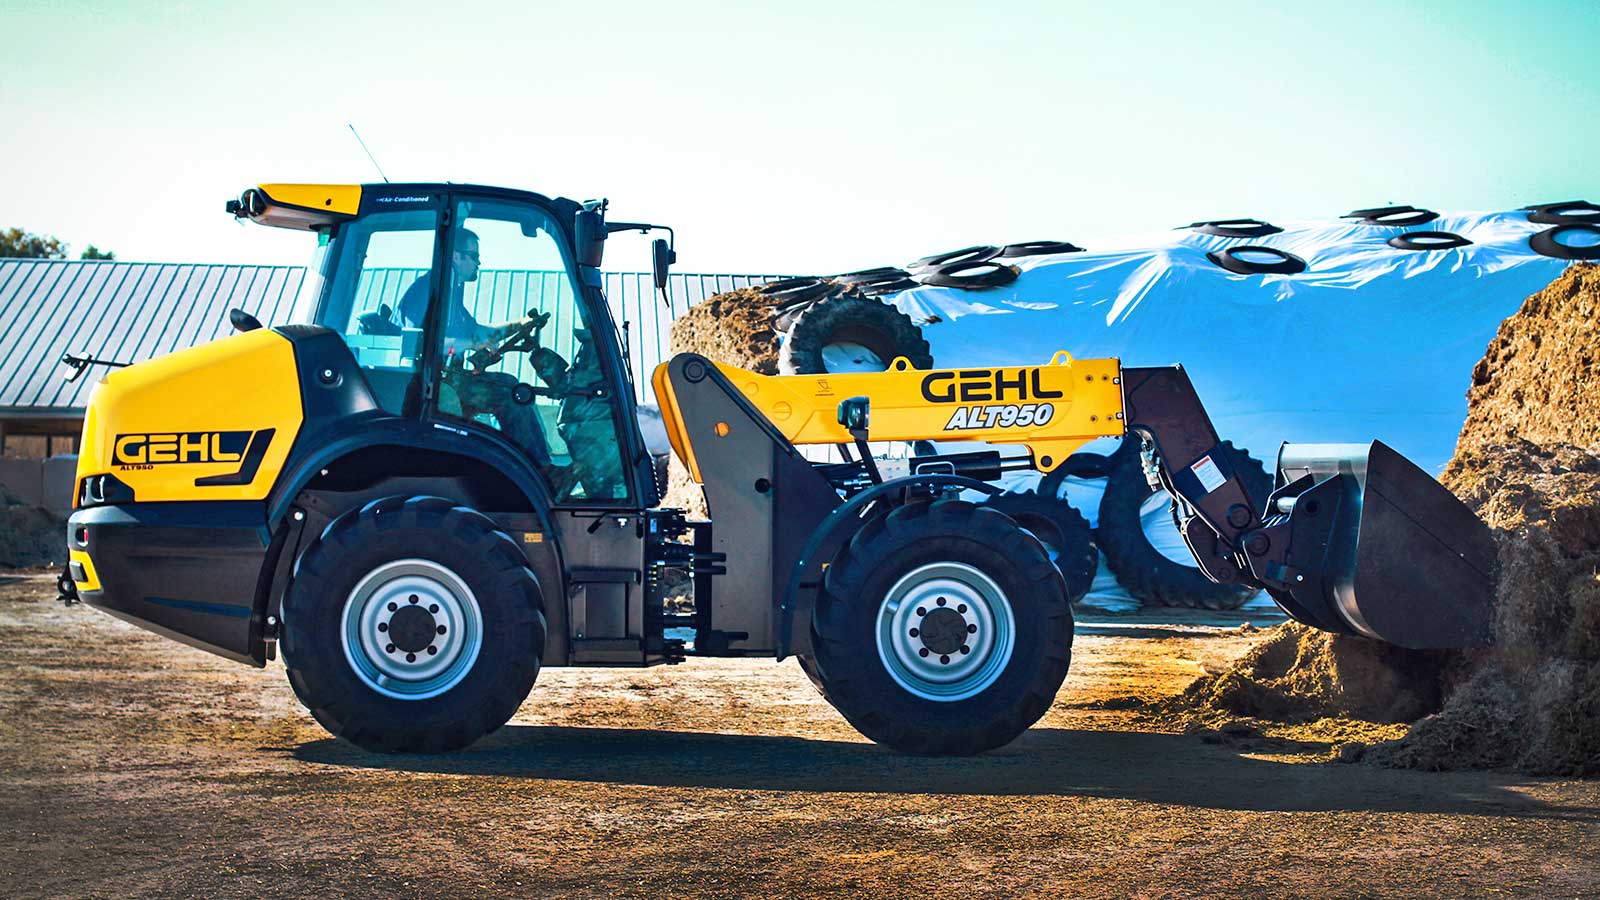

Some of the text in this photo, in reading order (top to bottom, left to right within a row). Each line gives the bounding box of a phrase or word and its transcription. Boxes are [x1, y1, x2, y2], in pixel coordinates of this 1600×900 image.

[921, 368, 1063, 403] GEHL
[944, 403, 1054, 431] ALT950
[116, 433, 240, 464] GEHL
